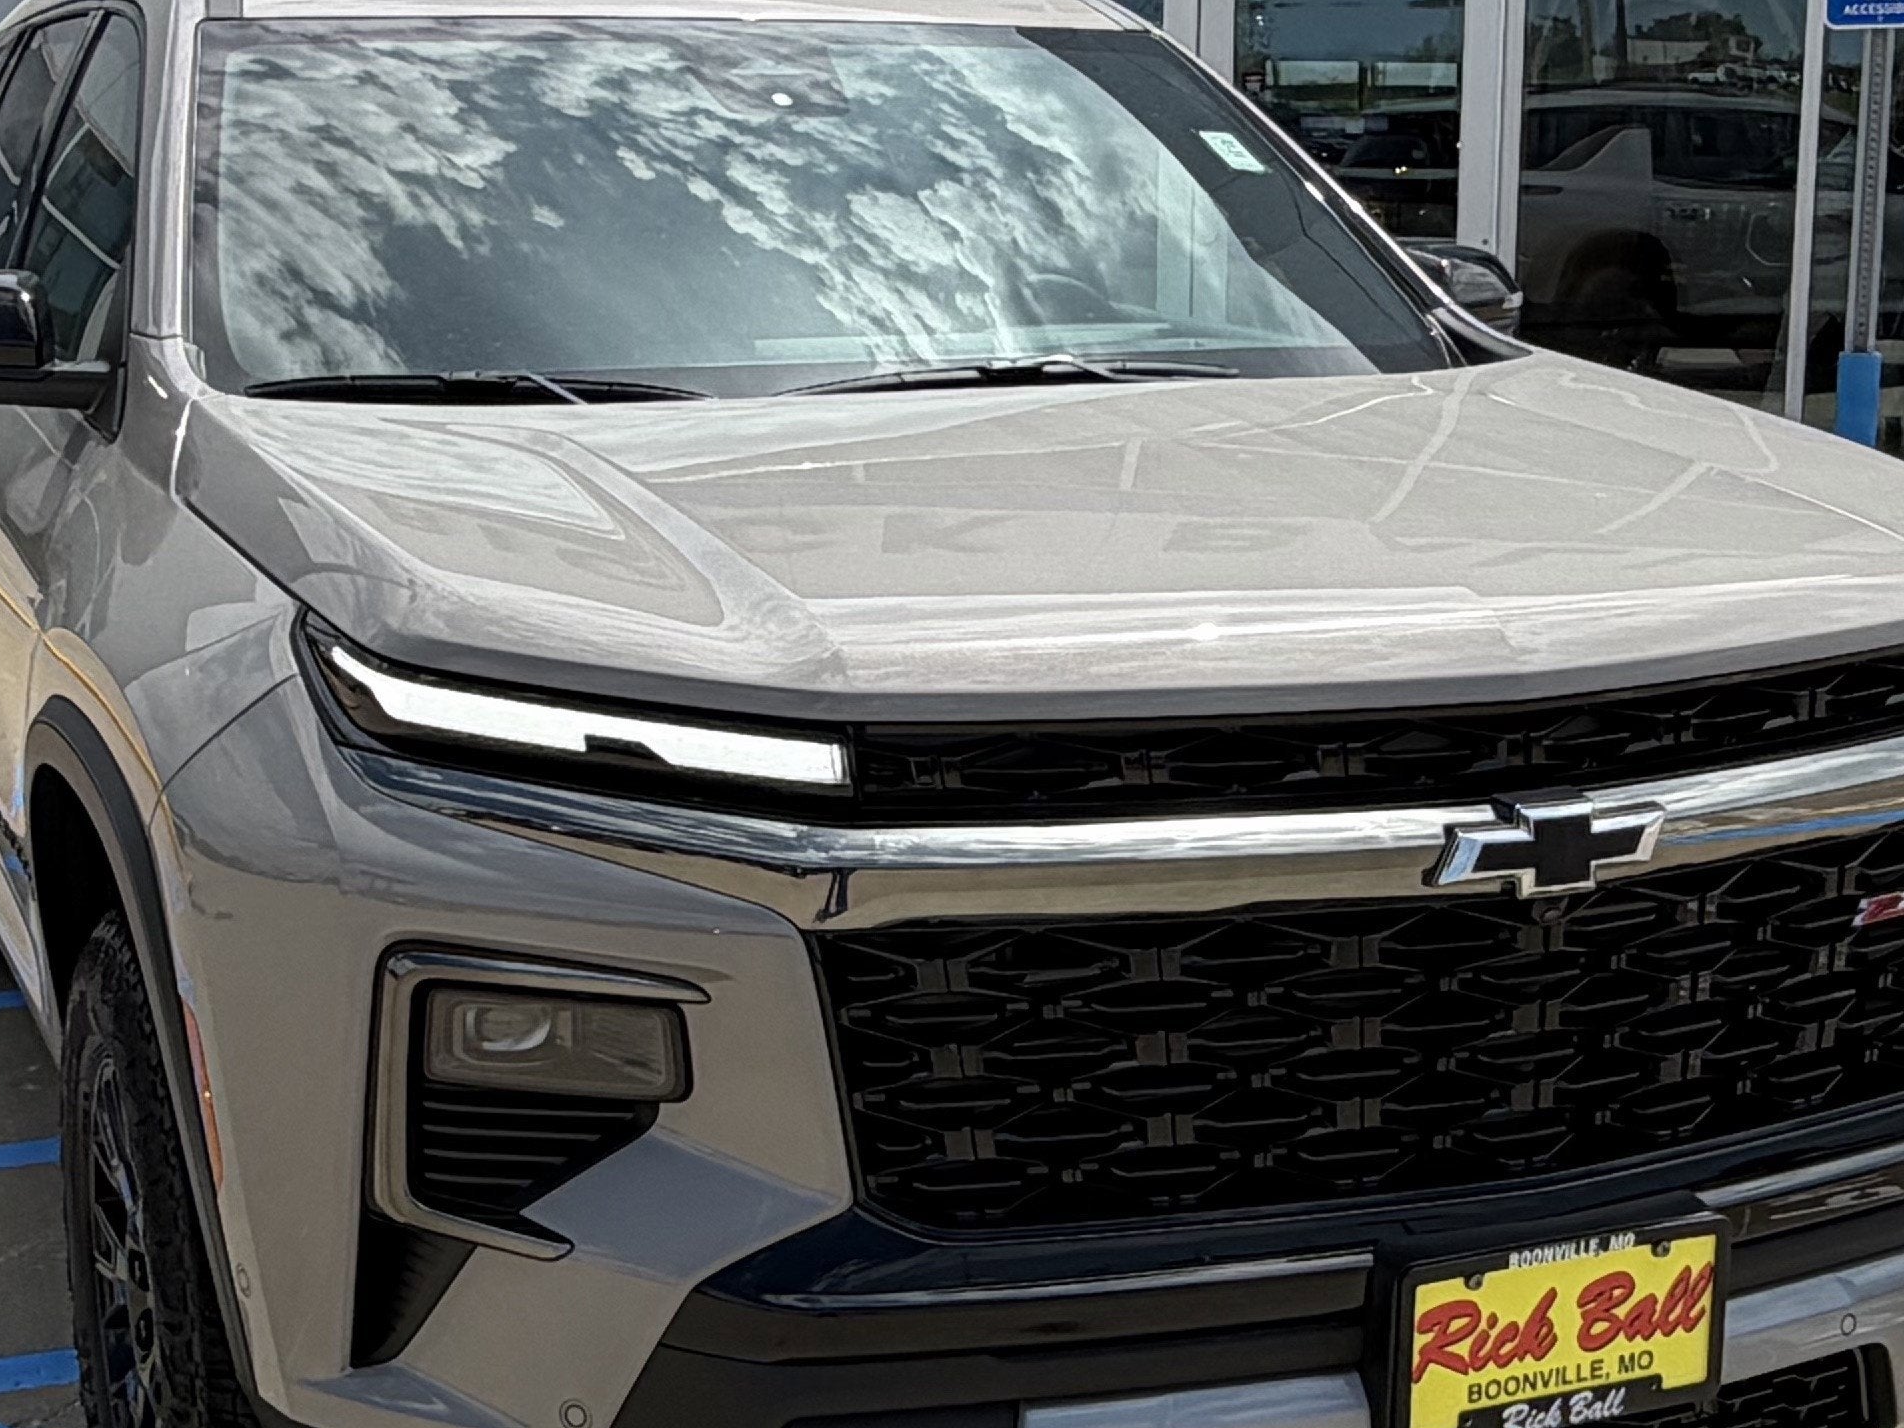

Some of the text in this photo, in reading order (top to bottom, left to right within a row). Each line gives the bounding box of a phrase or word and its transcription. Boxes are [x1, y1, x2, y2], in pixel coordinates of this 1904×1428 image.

[1508, 1232, 1636, 1270] BOONVILLE, MO
[1412, 1260, 1715, 1384] Rick Ball
[1466, 1349, 1655, 1404] BOONVILLE, MO
[1569, 1387, 1627, 1428] Ball
